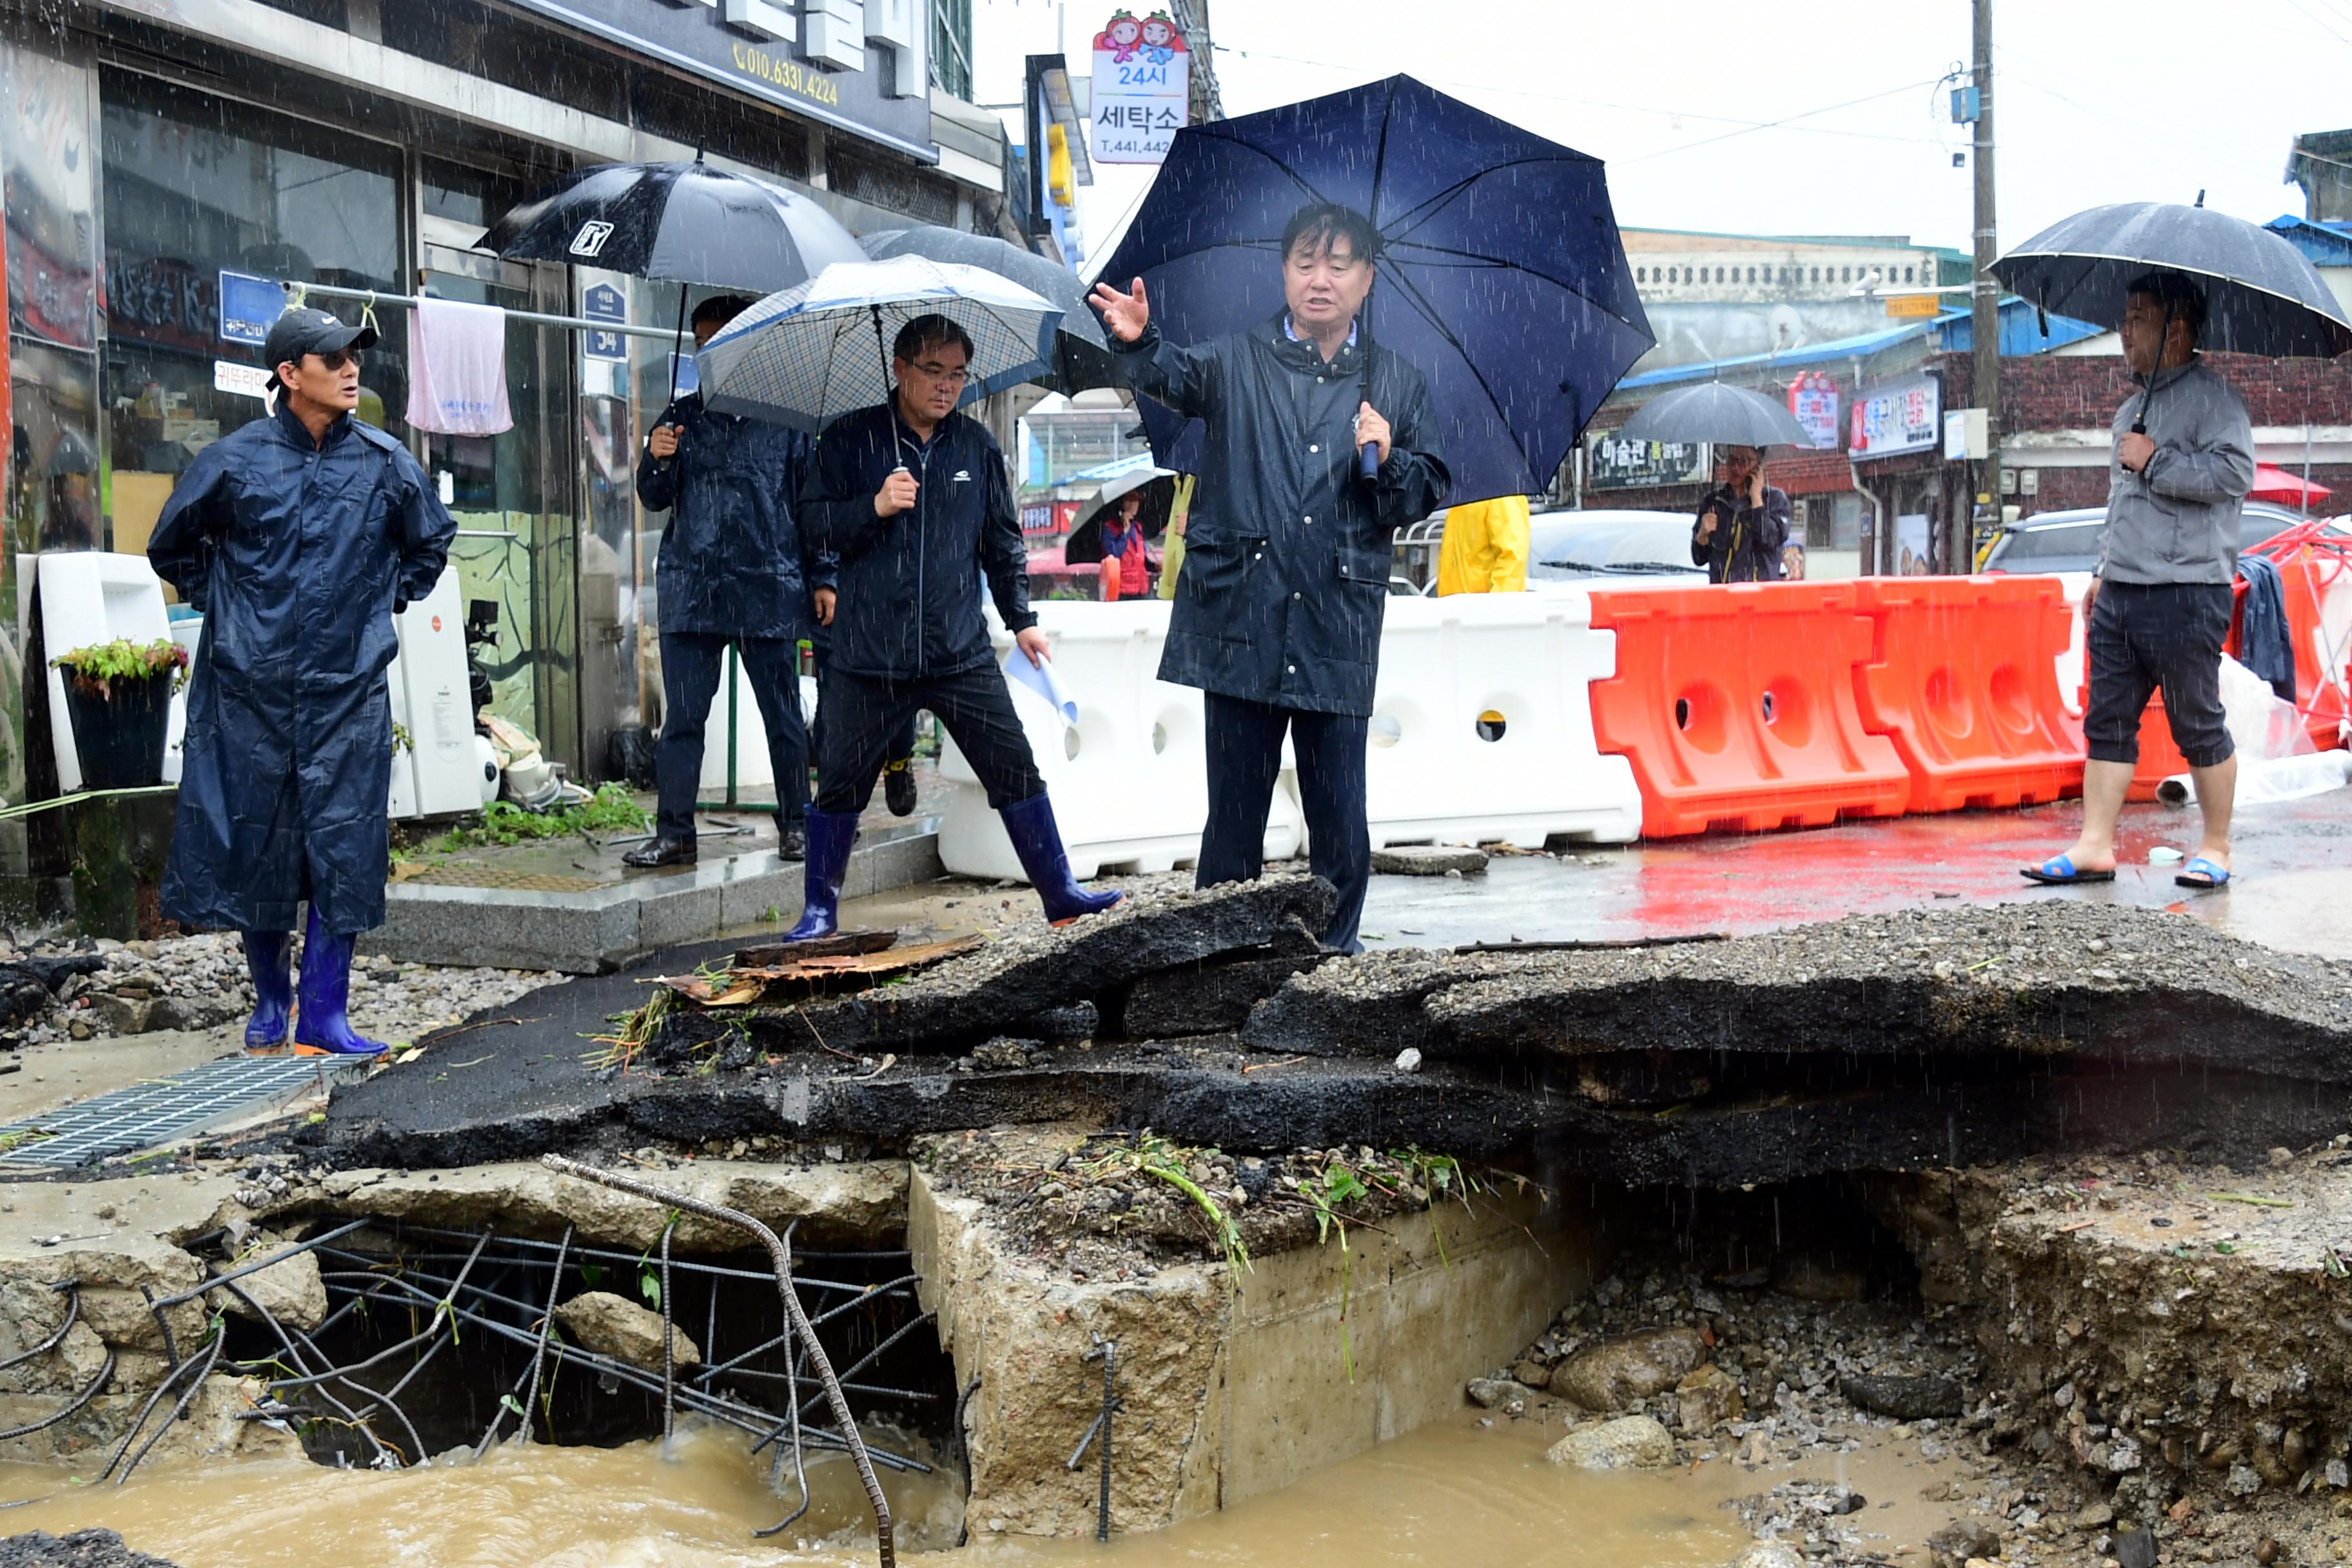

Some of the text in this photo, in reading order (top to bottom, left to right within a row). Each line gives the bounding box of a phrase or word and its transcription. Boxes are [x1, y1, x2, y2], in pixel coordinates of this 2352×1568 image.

[747, 48, 838, 106] 010.6331.4224
[1119, 66, 1166, 86] 24시
[1097, 106, 1179, 135] 세탁소
[1101, 139, 1169, 154] T.441.442
[217, 364, 266, 394] 귀뚜라미
[1602, 436, 1647, 467] 미술관
